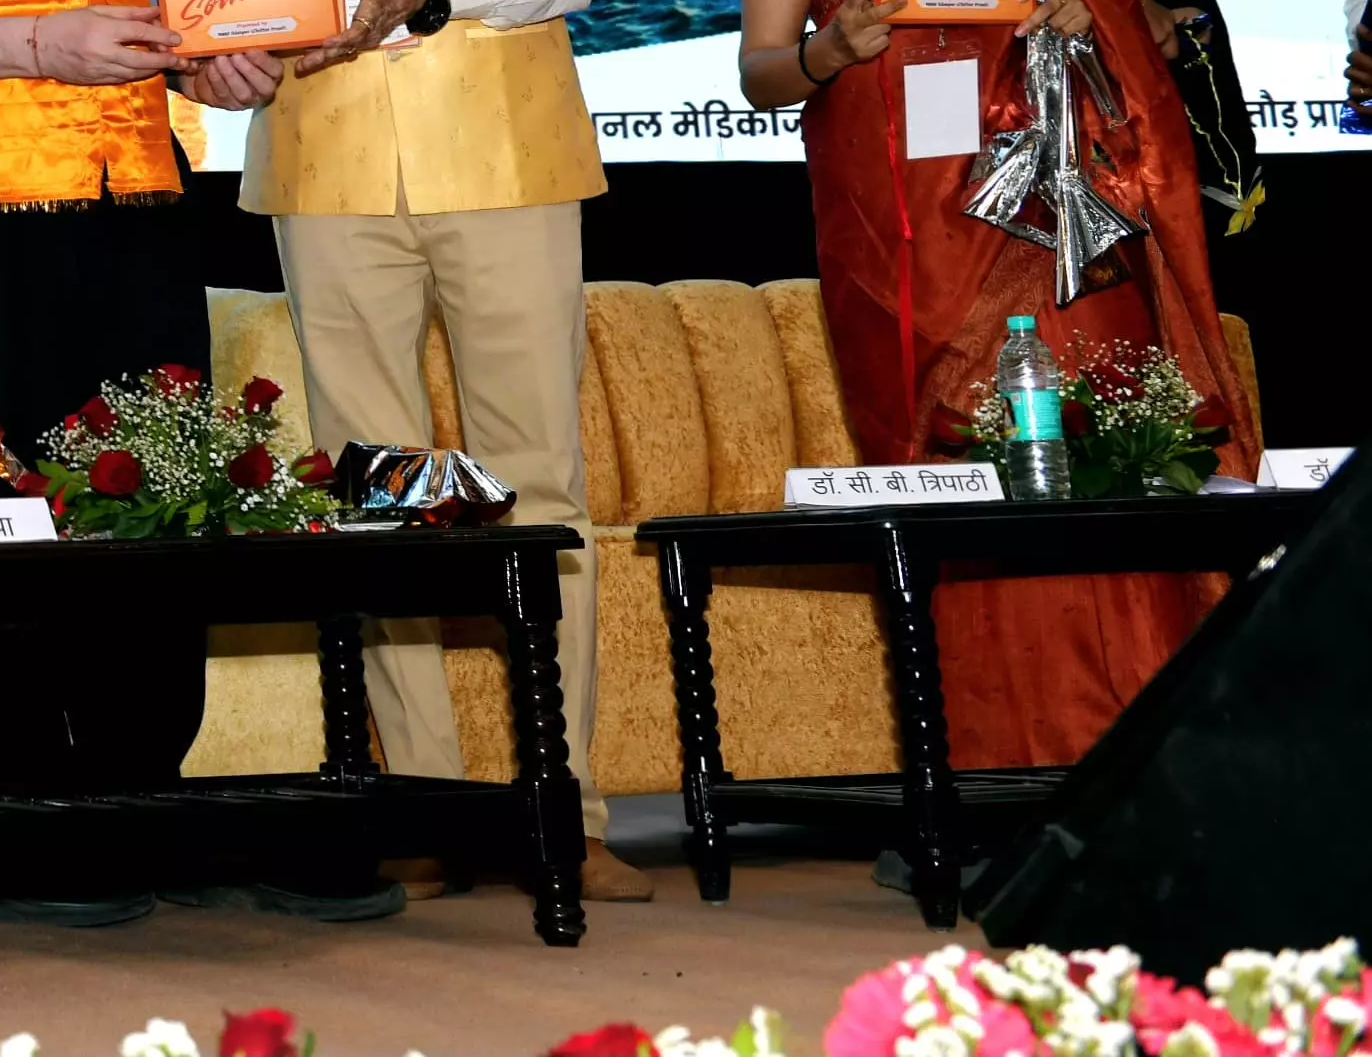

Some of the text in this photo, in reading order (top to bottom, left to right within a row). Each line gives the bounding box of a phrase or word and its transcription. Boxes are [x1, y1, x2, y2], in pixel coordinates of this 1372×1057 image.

[807, 468, 989, 495] डॉ. सी. बी. त्रिपाठी
